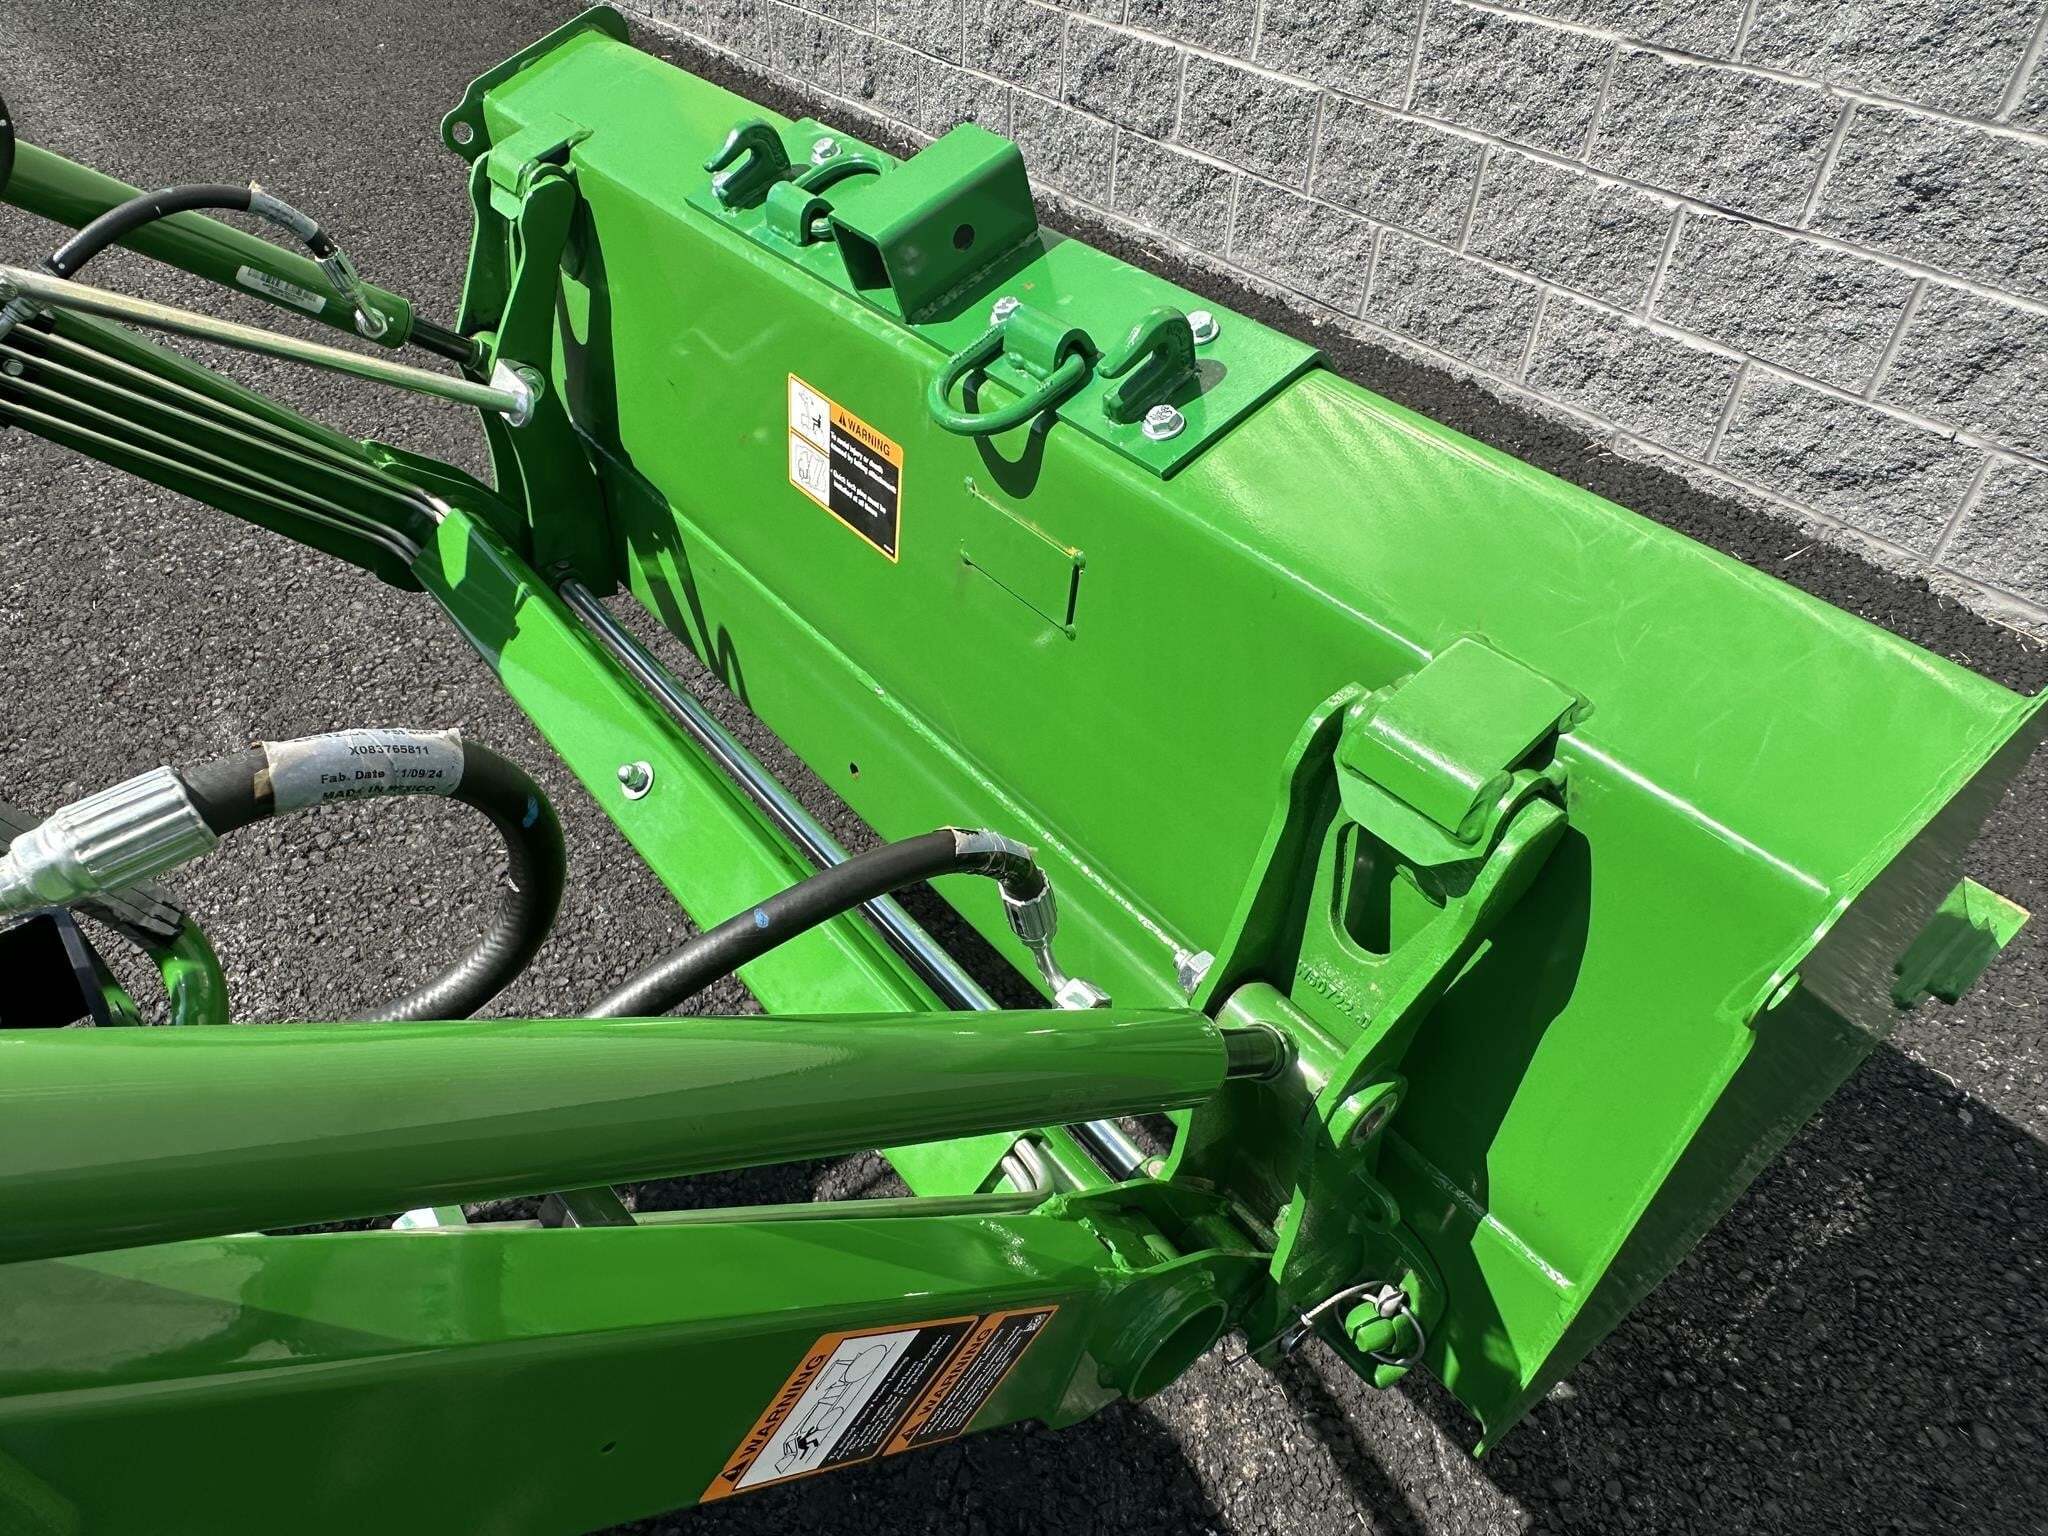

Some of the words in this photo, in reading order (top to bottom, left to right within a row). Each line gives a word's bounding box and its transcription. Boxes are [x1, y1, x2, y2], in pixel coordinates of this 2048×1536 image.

[848, 417, 890, 457] WARNING
[350, 745, 430, 756] X083765811
[355, 769, 386, 780] Date
[395, 768, 443, 779] 1/09/24
[368, 785, 384, 794] IN
[918, 1327, 993, 1417] WARNING
[739, 1354, 827, 1458] WARNING
